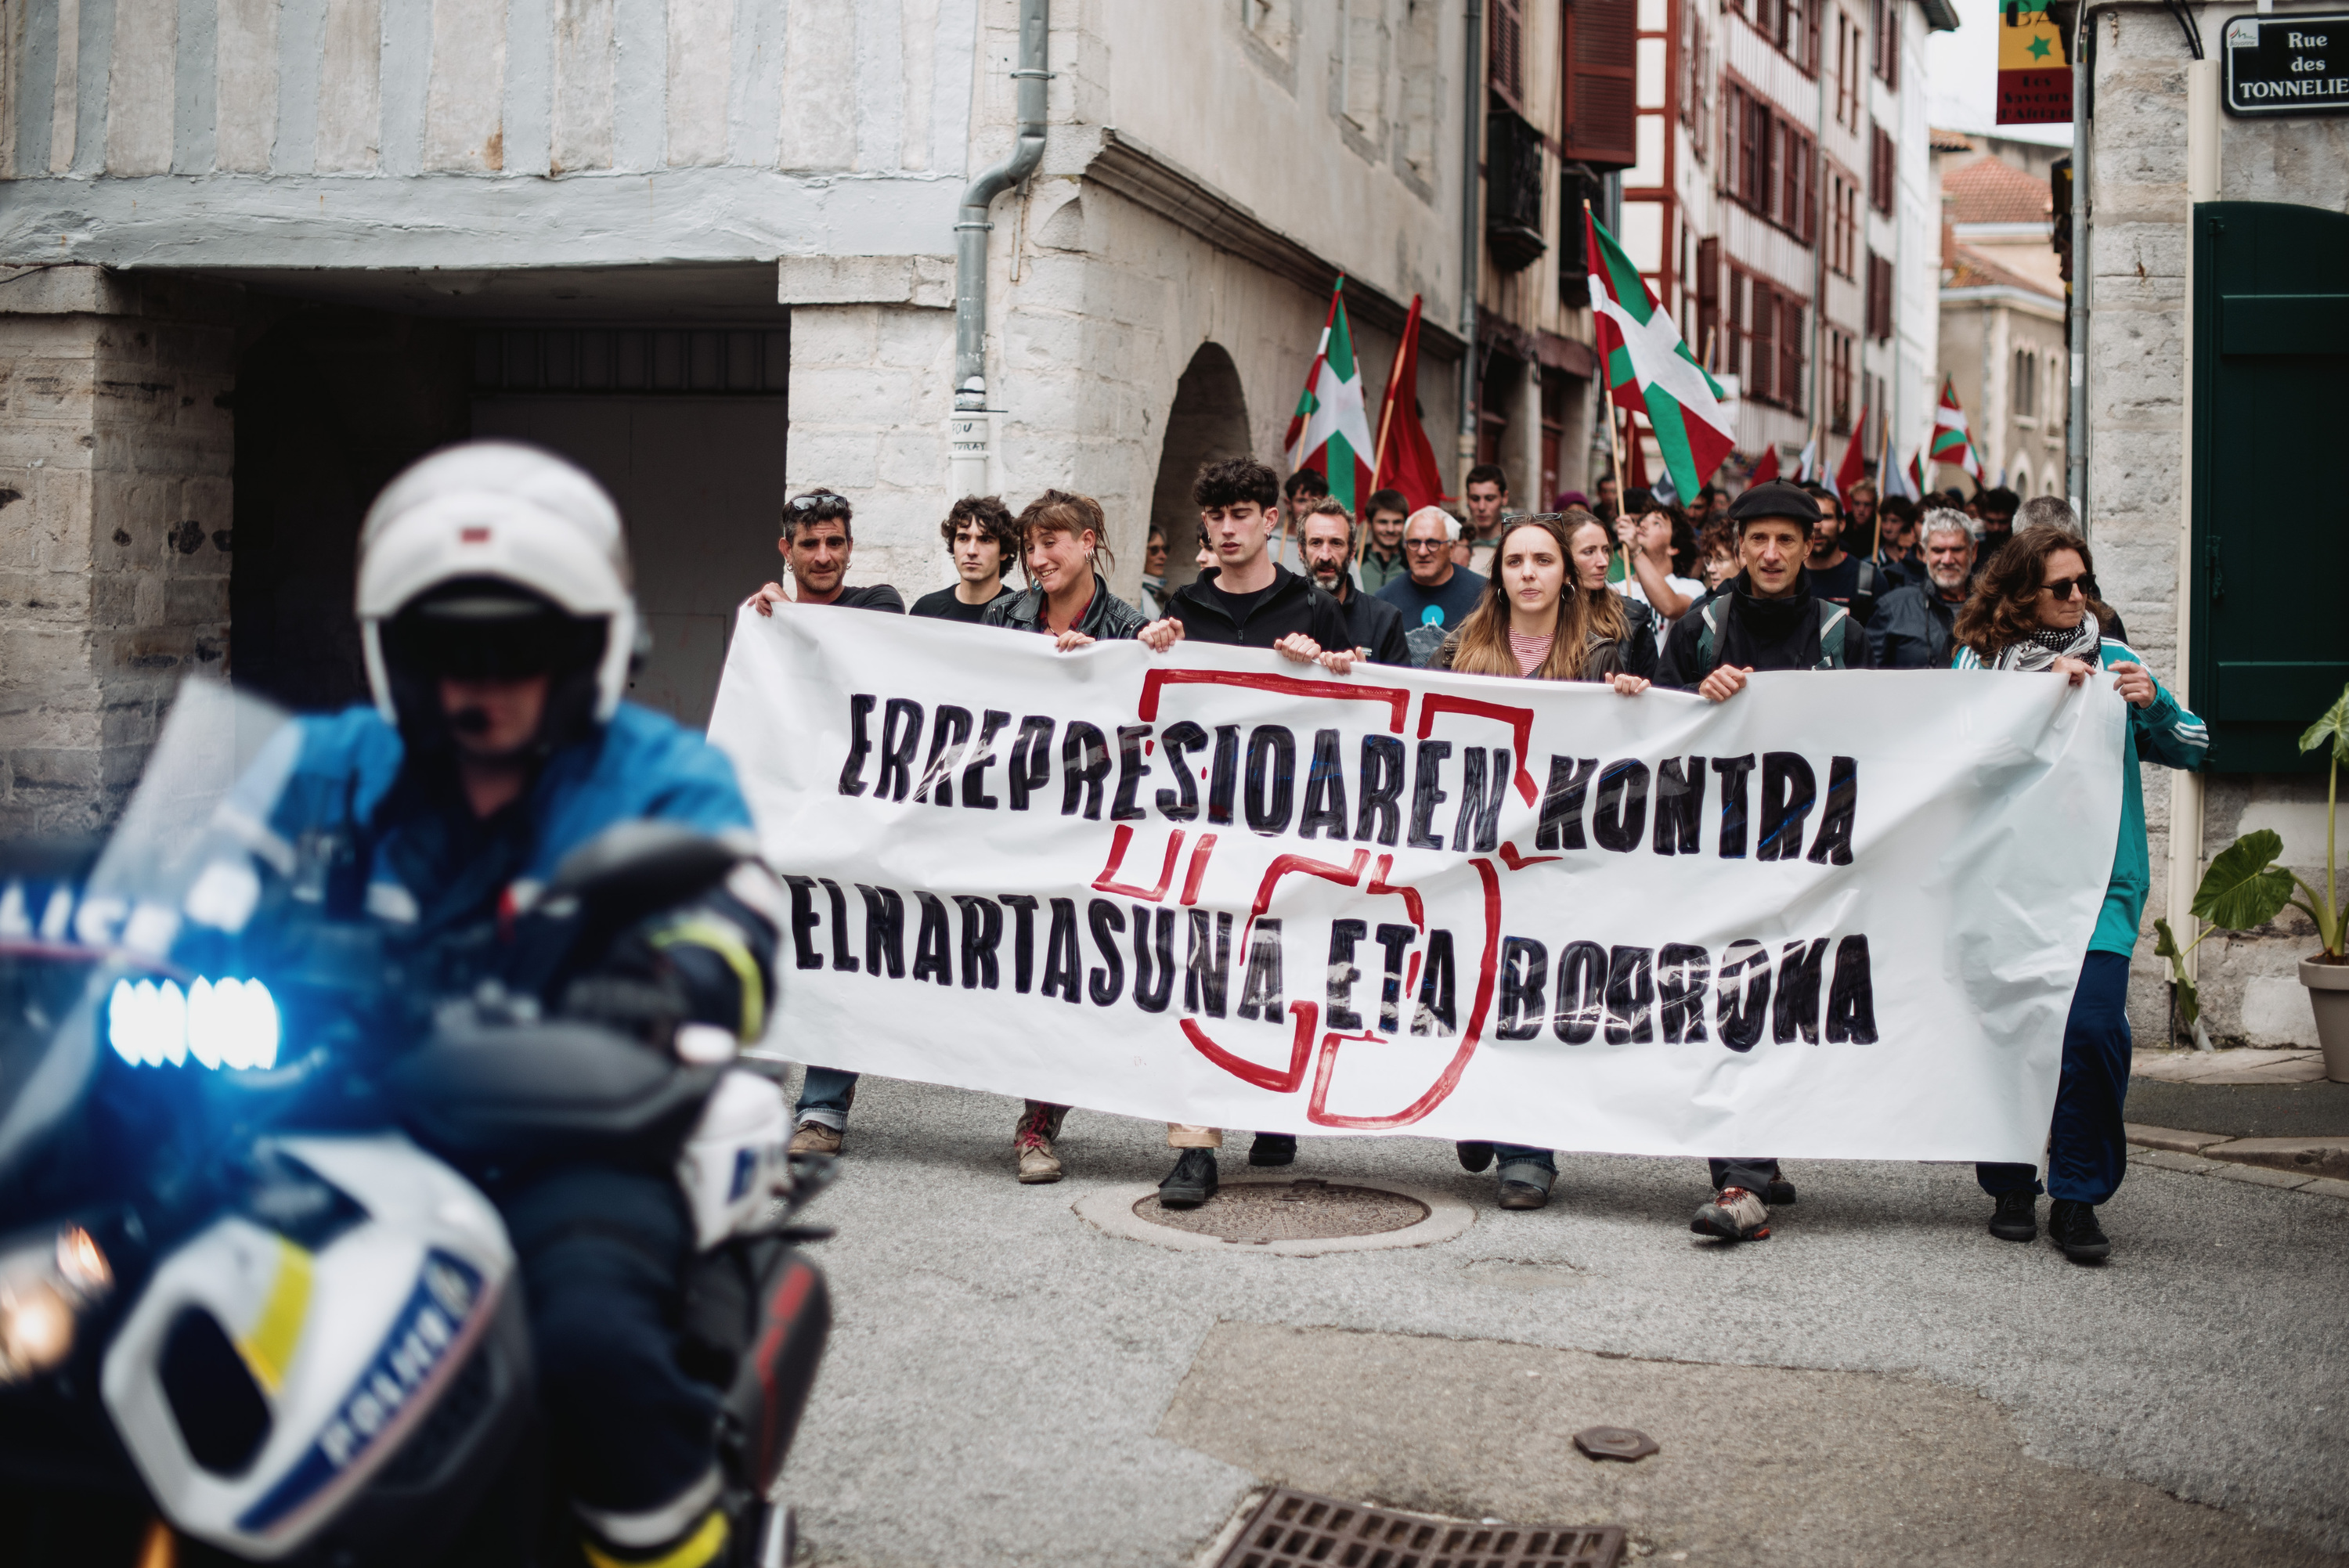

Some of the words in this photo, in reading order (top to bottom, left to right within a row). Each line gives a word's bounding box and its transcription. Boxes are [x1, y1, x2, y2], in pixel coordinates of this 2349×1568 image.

[2288, 32, 2329, 49] Rue
[2291, 56, 2326, 72] des
[2239, 78, 2349, 99] TONNELIE
[838, 693, 1511, 853] ERREPRESIOAREN
[1535, 751, 1859, 866] KONTRA
[1325, 918, 1457, 1038] ETA
[1495, 933, 1879, 1053] BORROKA
